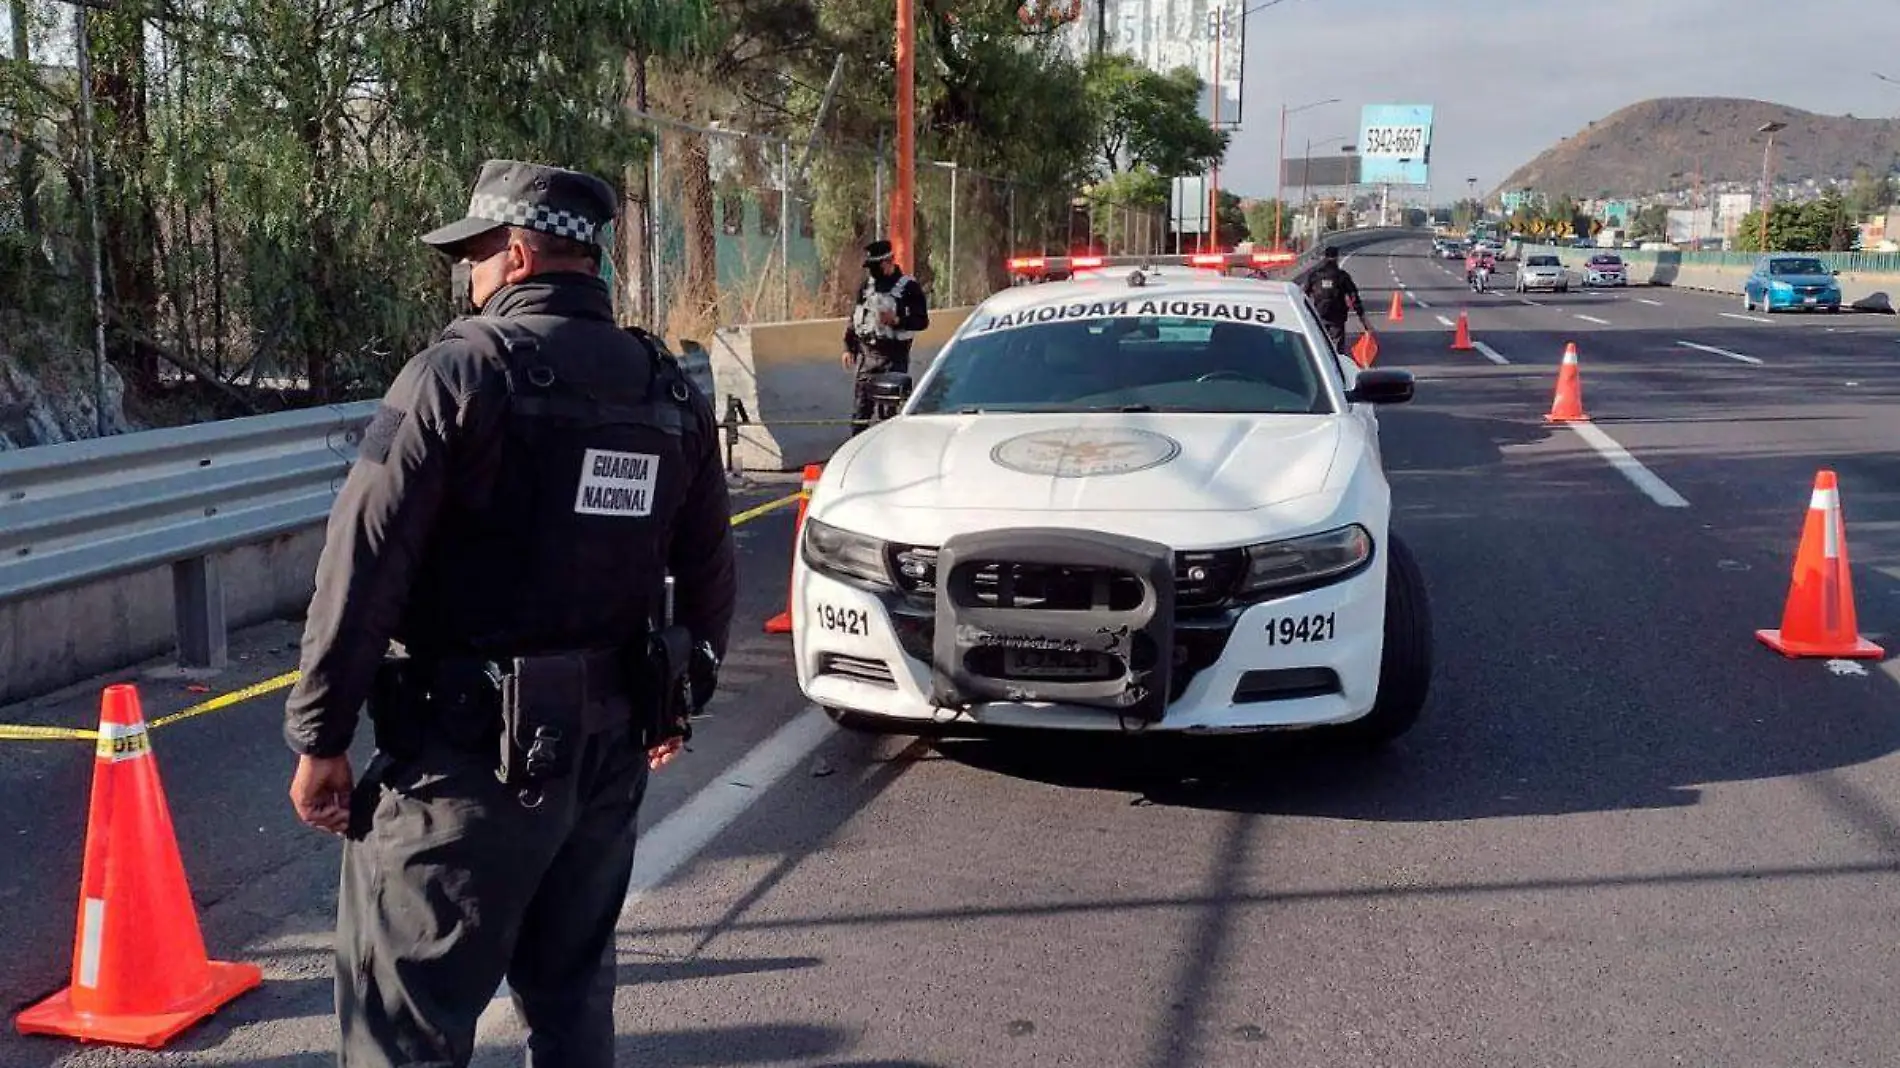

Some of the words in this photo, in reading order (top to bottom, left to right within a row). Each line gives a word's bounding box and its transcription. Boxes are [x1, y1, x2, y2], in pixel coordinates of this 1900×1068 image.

[593, 454, 648, 480] GUARDIA
[582, 485, 646, 512] NACIONAL
[816, 602, 869, 637] 19421
[1264, 611, 1336, 647] 19421
